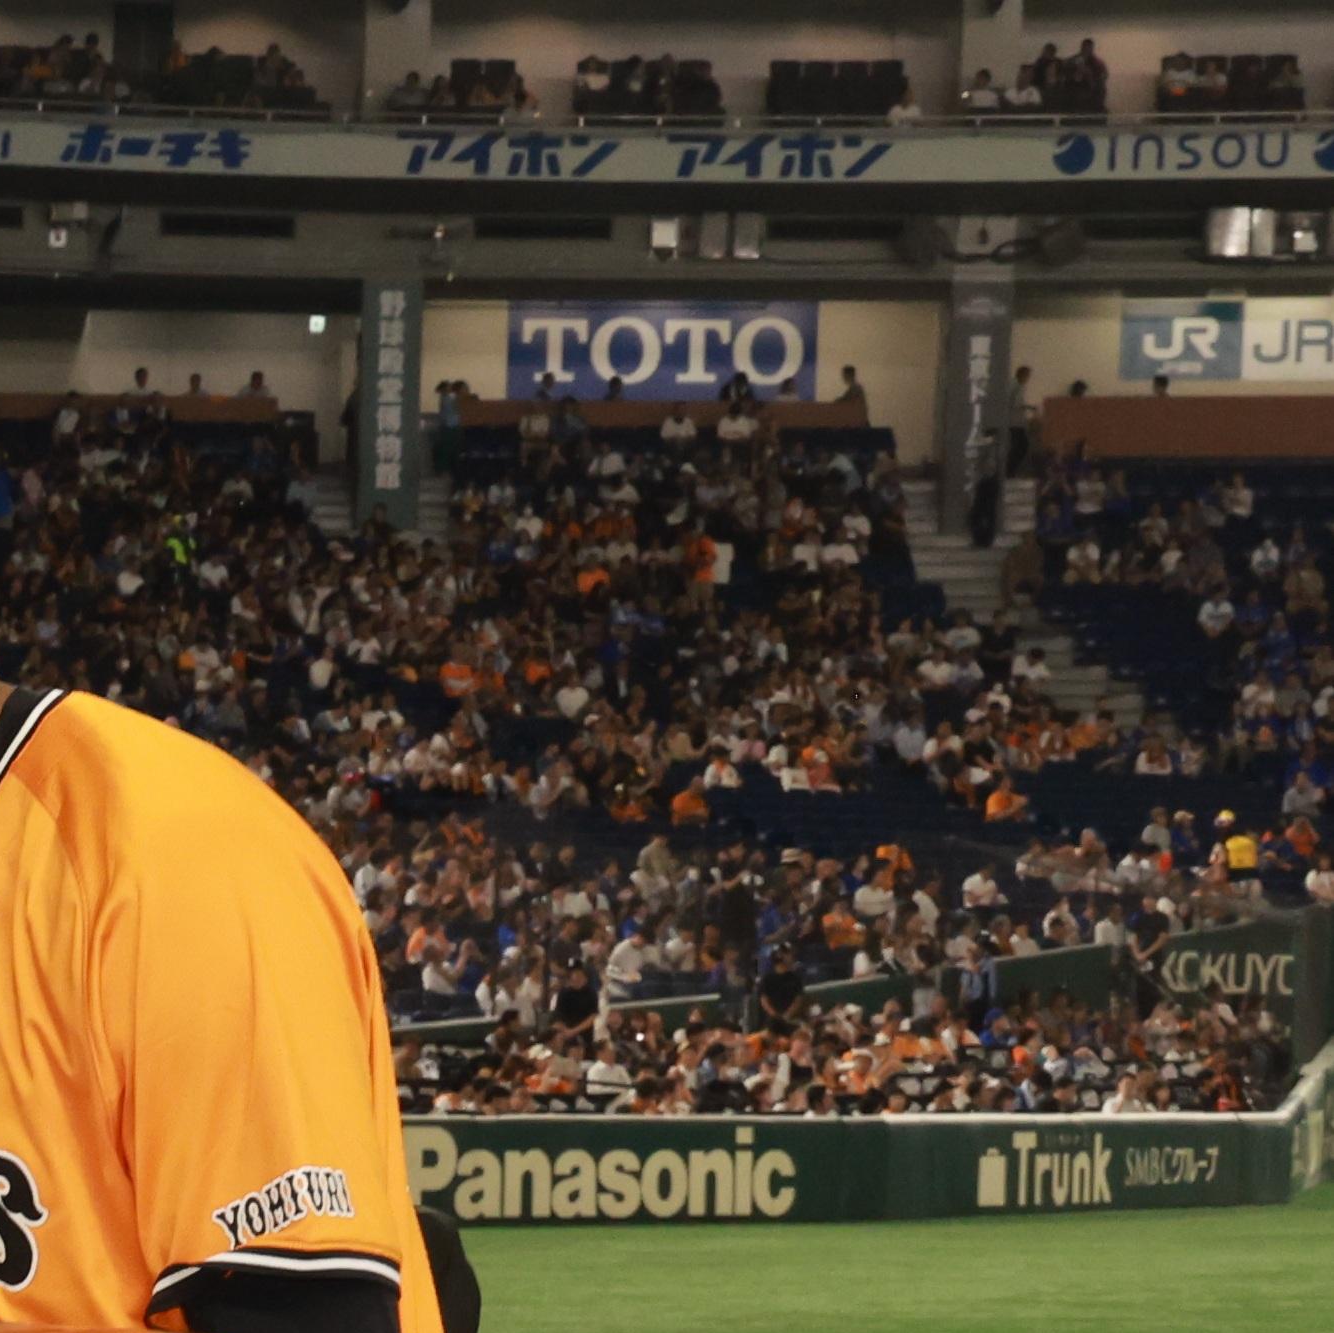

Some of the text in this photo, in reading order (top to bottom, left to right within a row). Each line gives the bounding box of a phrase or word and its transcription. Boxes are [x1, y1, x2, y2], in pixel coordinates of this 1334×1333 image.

[60, 123, 252, 169] ホーチキ
[395, 130, 622, 178] アイホン
[666, 133, 893, 178] アイホン
[522, 316, 804, 386] TOTO
[1143, 316, 1220, 360] JR
[402, 1125, 797, 1221] Panasonic
[1012, 1130, 1113, 1207] Trunk
